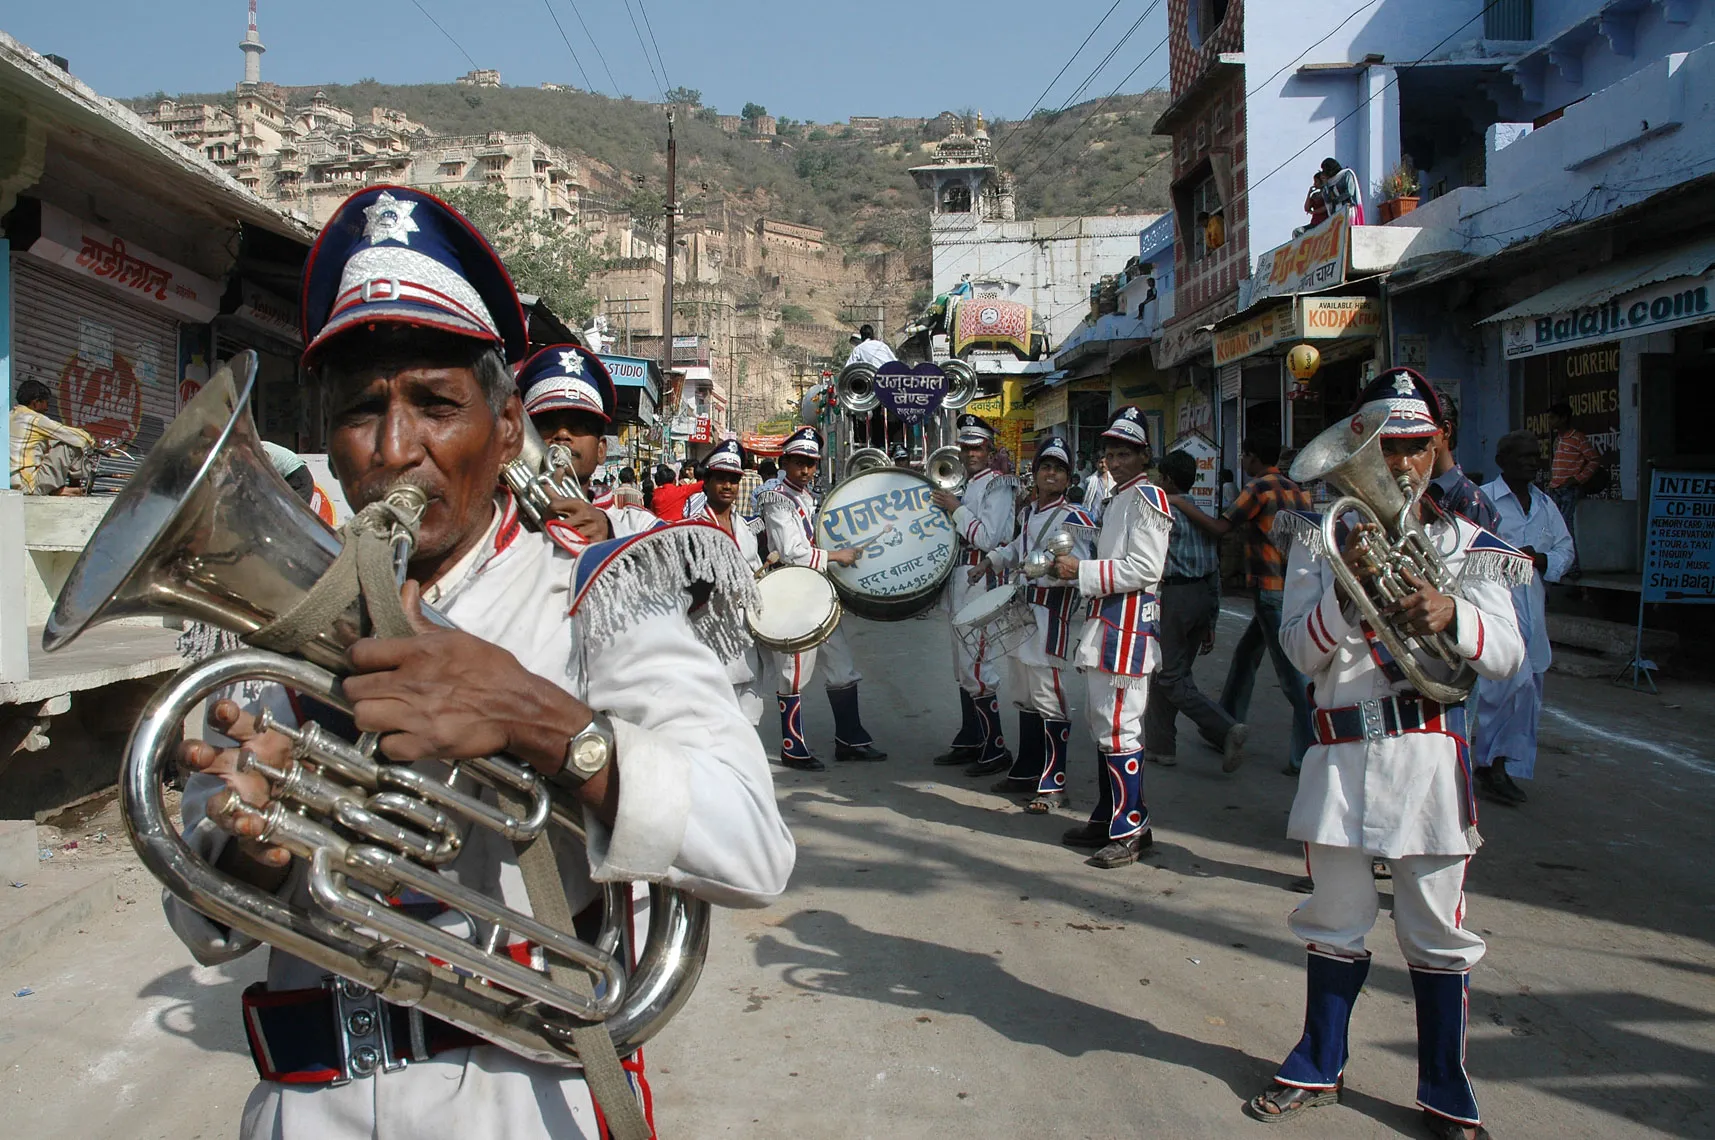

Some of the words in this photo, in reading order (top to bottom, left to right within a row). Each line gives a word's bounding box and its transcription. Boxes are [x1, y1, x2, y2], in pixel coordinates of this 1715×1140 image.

[1316, 262, 1336, 282] चाय
[1309, 310, 1358, 328] KODAK
[1535, 286, 1709, 344] Balaji.com
[1217, 331, 1249, 361] KODAK
[608, 362, 643, 377] STUDIO
[876, 374, 945, 390] राजकमल
[1568, 389, 1620, 416] BUSINES
[1652, 519, 1682, 528] MEMORY
[1658, 540, 1682, 549] TOUR
[1659, 550, 1694, 559] INQUIRY
[858, 569, 889, 589] सदर
[890, 556, 924, 577] बाजार
[1685, 561, 1711, 569] MUSIC
[1650, 573, 1679, 588] Shri
